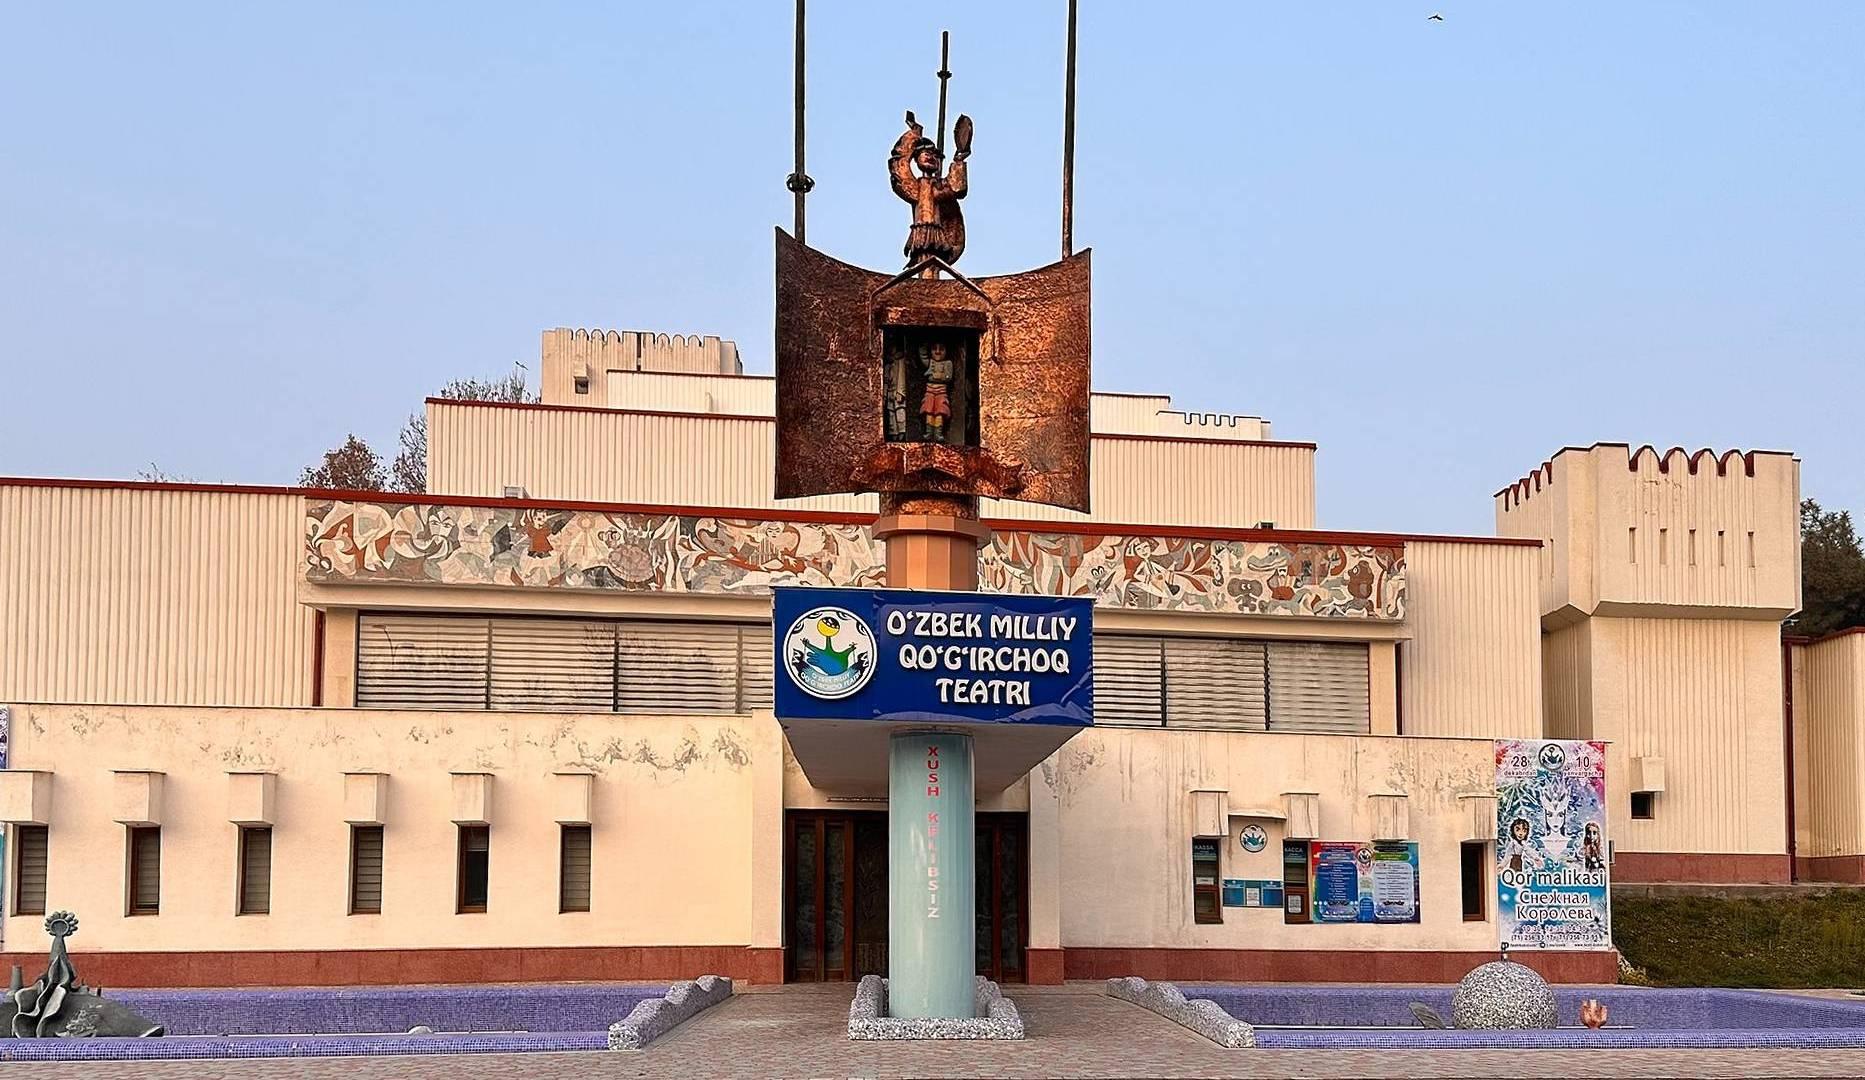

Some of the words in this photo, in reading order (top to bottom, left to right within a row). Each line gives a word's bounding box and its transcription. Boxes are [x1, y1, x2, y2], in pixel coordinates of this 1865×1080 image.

[886, 610, 983, 638] O‘ZBEK
[990, 614, 1077, 641] MILLIY
[898, 647, 1071, 674] QO‘G‘IRCHOQ
[935, 678, 1031, 705] TEATRI
[927, 746, 940, 797] XUSH
[1512, 755, 1528, 768] 28
[1576, 756, 1590, 768] 10
[1502, 869, 1533, 887] Qor
[1538, 868, 1604, 885] malikasi
[1520, 890, 1588, 904] Снежная
[1517, 905, 1593, 923] Королева
